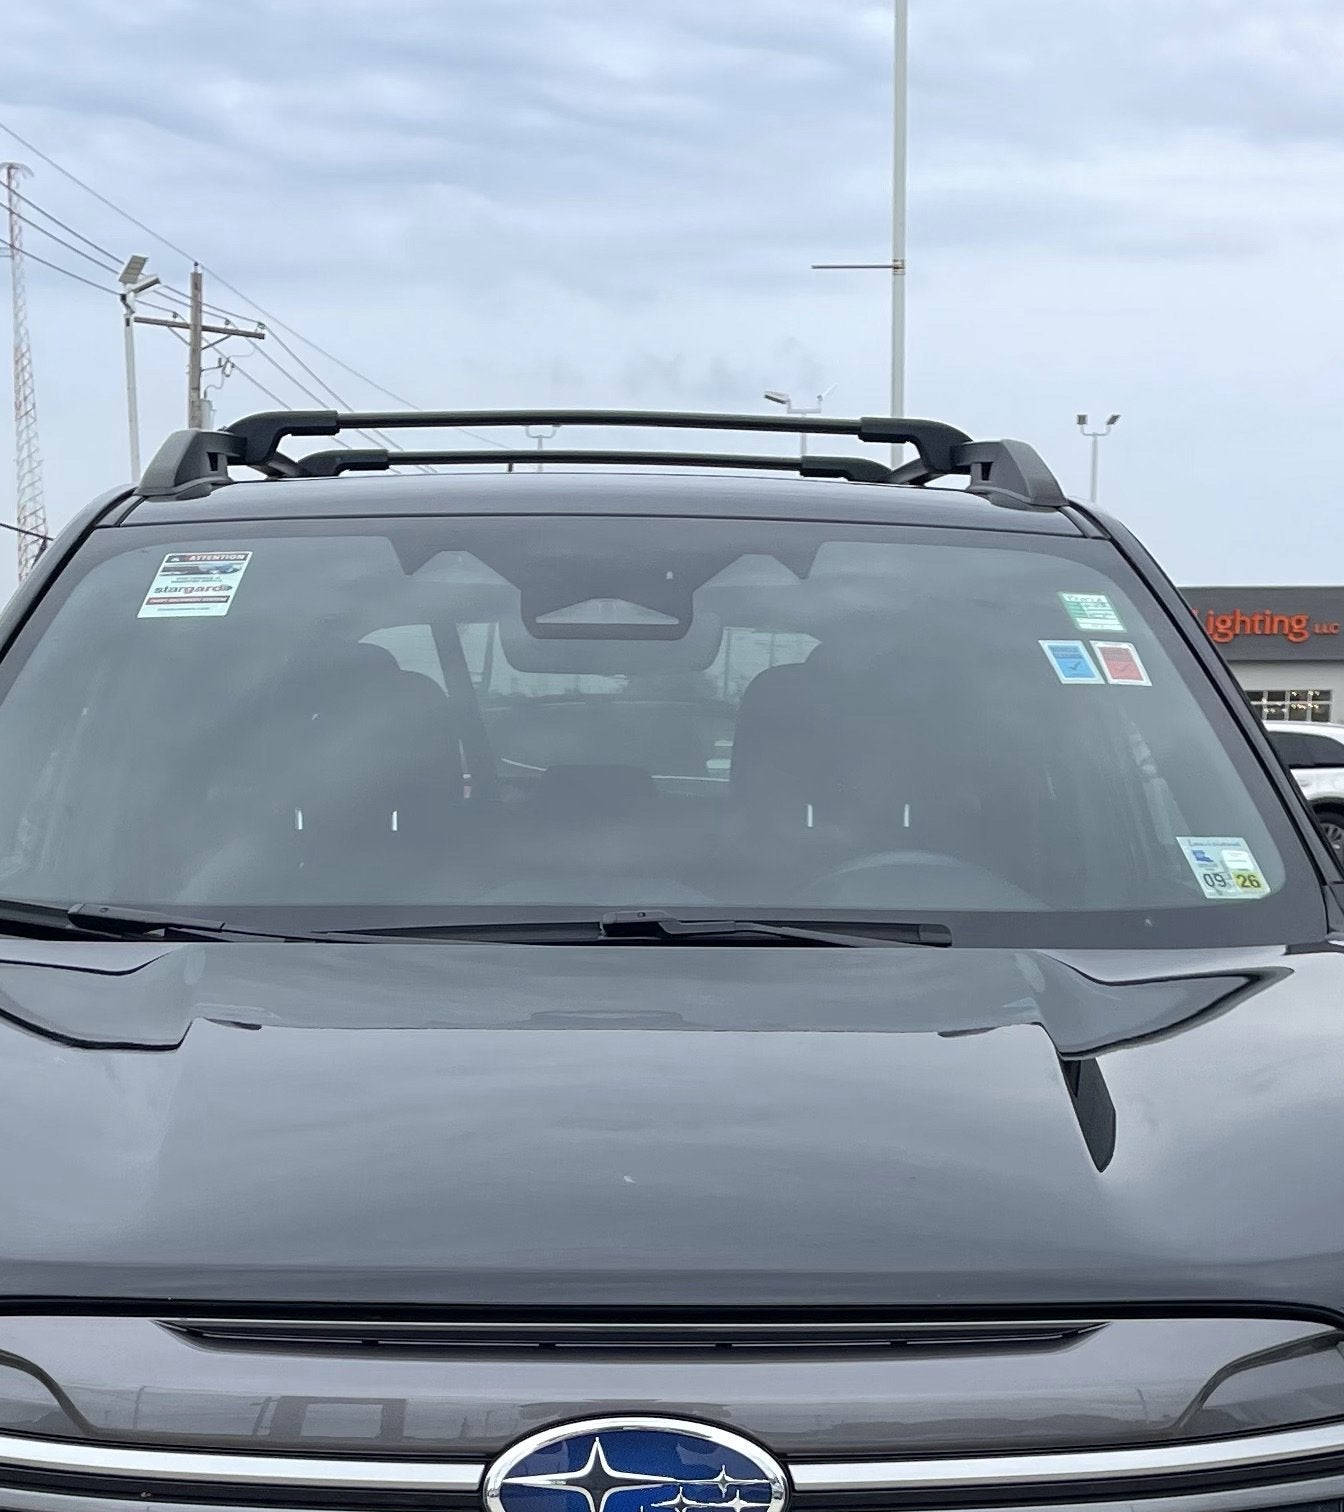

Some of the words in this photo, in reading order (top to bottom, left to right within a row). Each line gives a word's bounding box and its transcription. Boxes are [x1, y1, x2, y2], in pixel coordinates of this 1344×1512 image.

[1189, 608, 1309, 644] ighting
[1312, 622, 1341, 634] LLC
[1202, 873, 1227, 888] 09
[1236, 874, 1261, 888] 26
